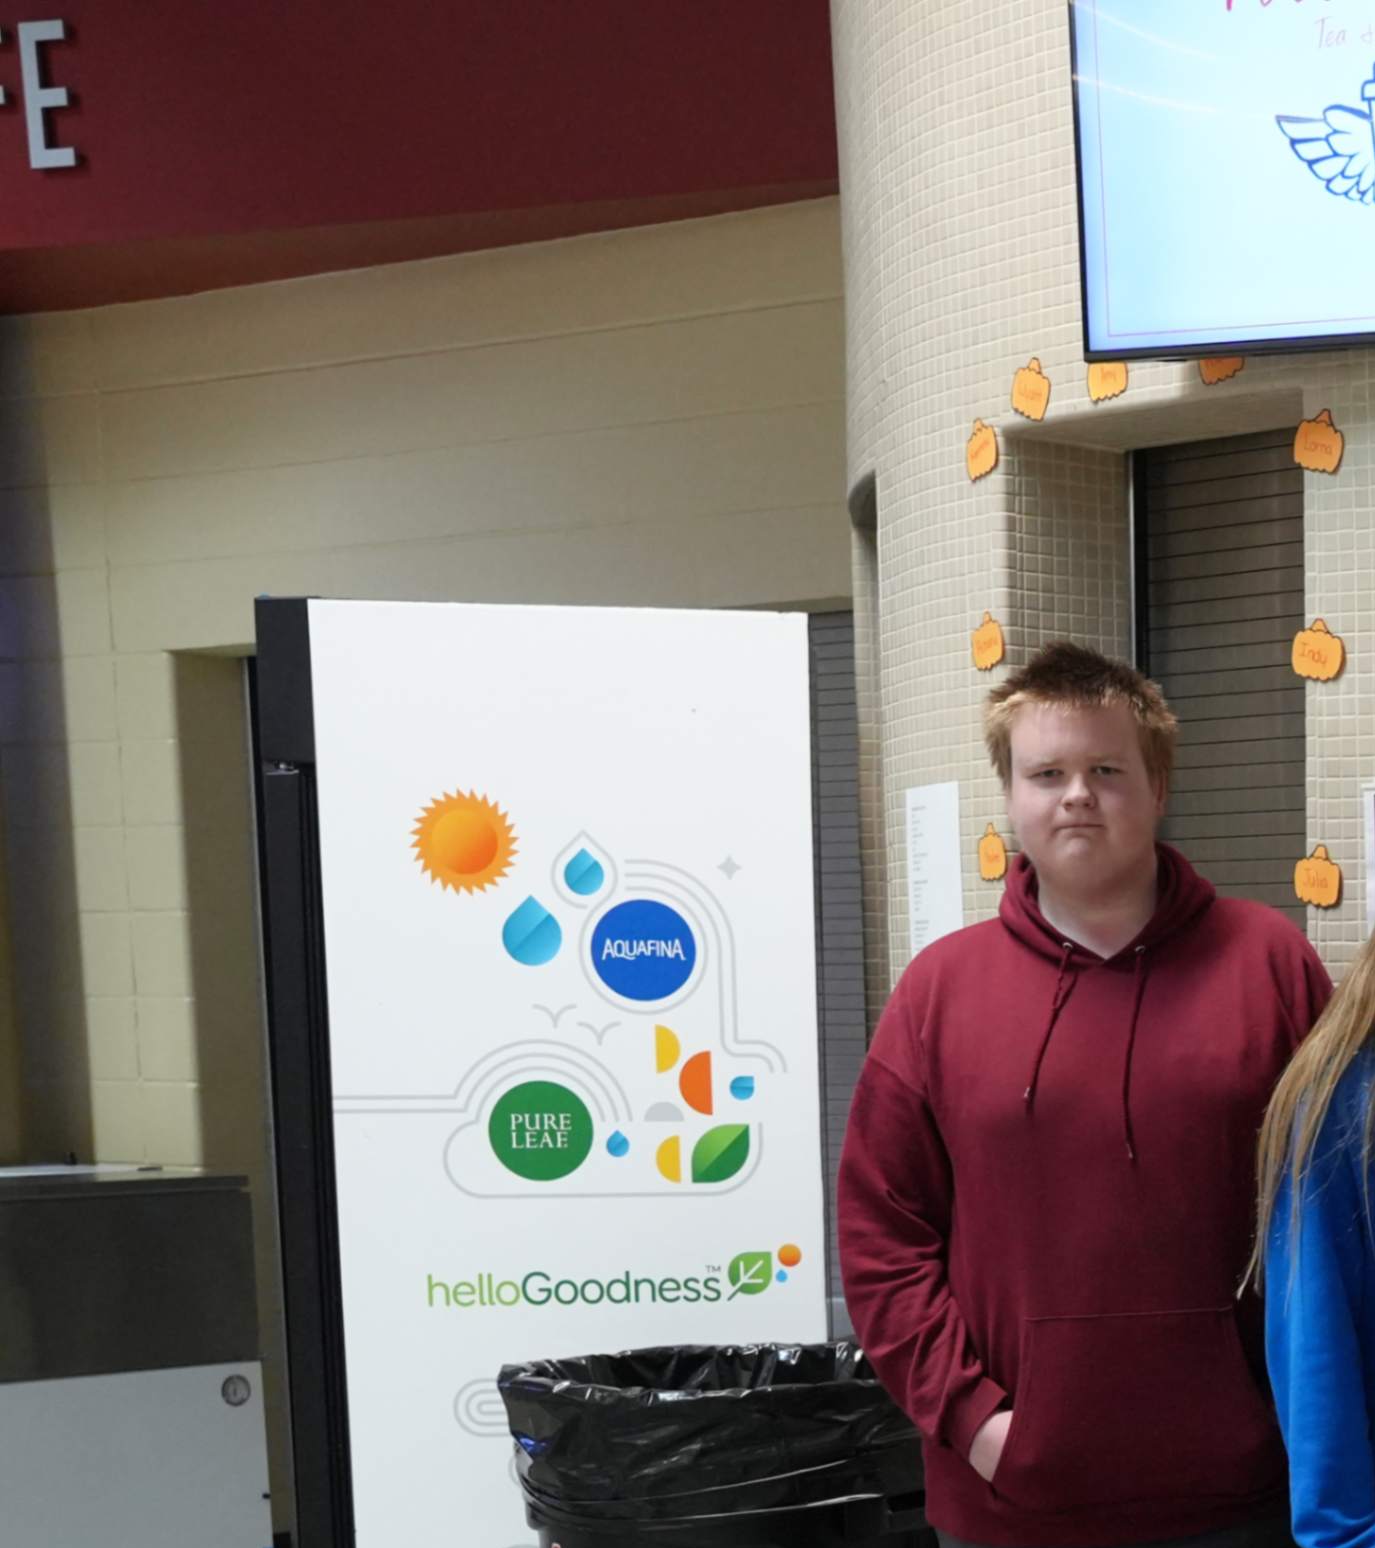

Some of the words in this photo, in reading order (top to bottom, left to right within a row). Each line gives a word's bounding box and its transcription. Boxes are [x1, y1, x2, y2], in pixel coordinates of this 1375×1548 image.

[1314, 16, 1347, 49] Tea
[0, 19, 77, 170] E
[601, 937, 687, 961] AQUAFINA
[509, 1113, 572, 1131] PURE
[510, 1131, 568, 1149] LEAF
[426, 1270, 721, 1308] helloGoodness
